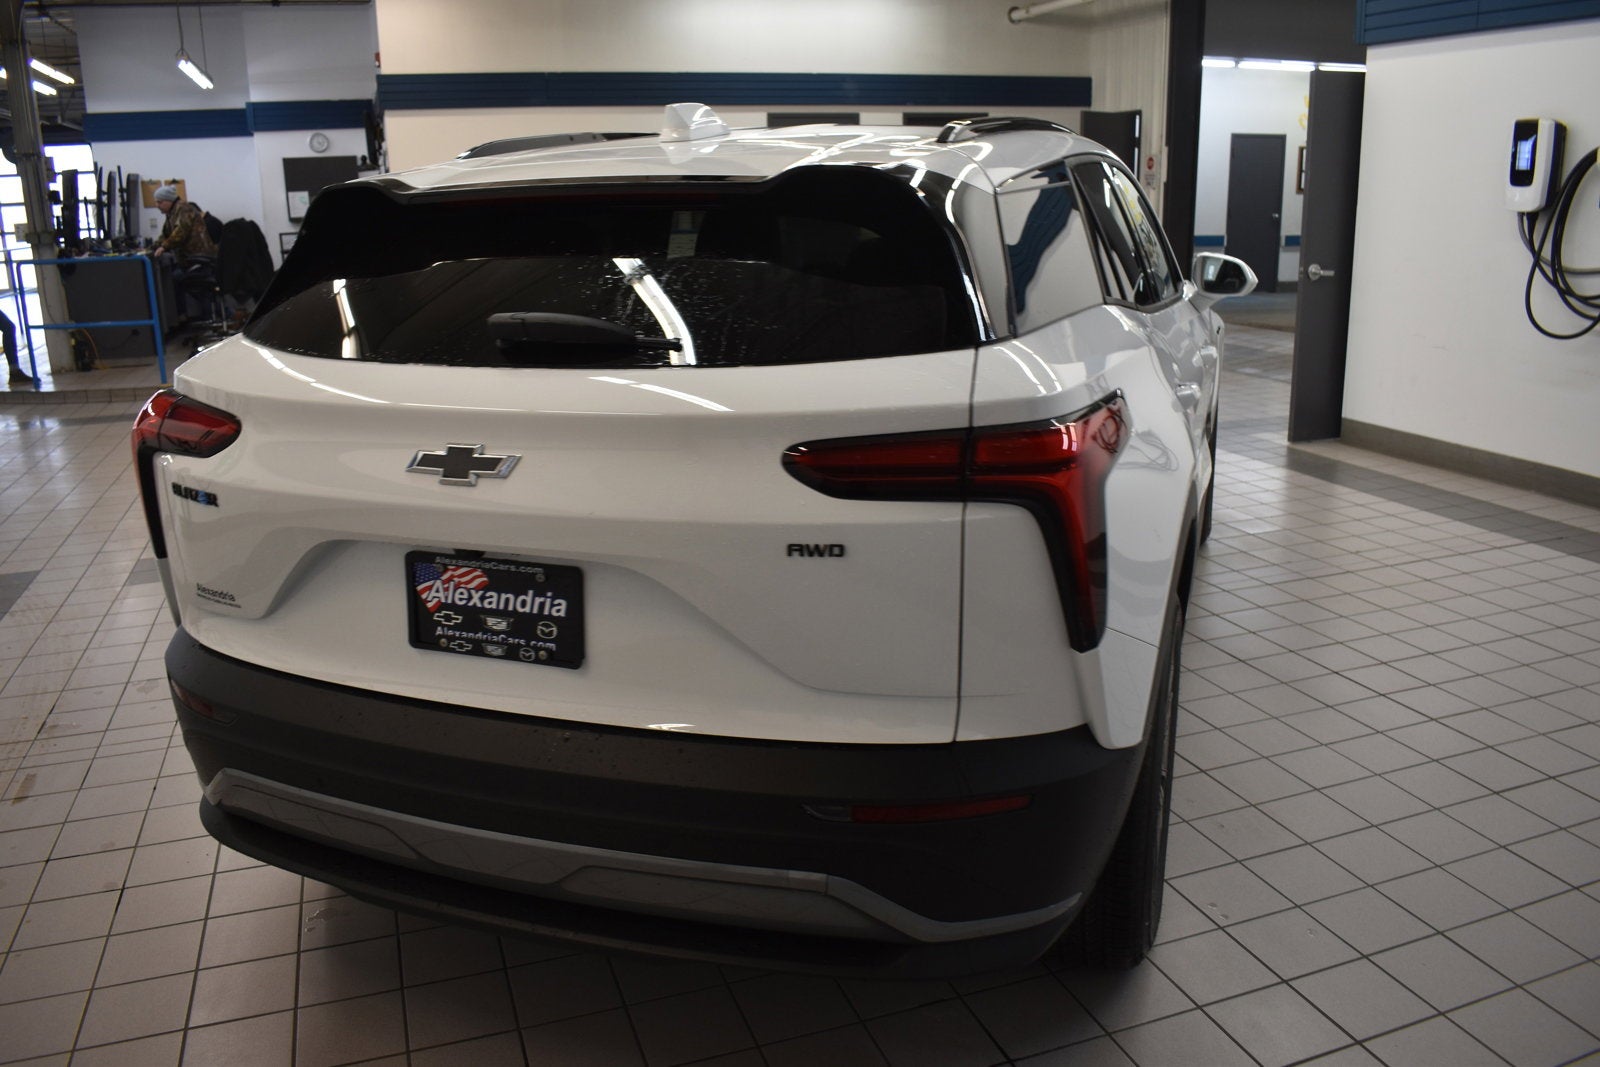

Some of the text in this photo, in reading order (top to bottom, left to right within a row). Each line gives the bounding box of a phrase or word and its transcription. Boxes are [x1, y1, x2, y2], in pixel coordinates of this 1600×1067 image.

[786, 543, 845, 558] AWD
[434, 556, 545, 574] AlexandriaCars.com
[427, 579, 568, 617] Alexandria
[435, 626, 557, 651] AlexandriaCarscom
